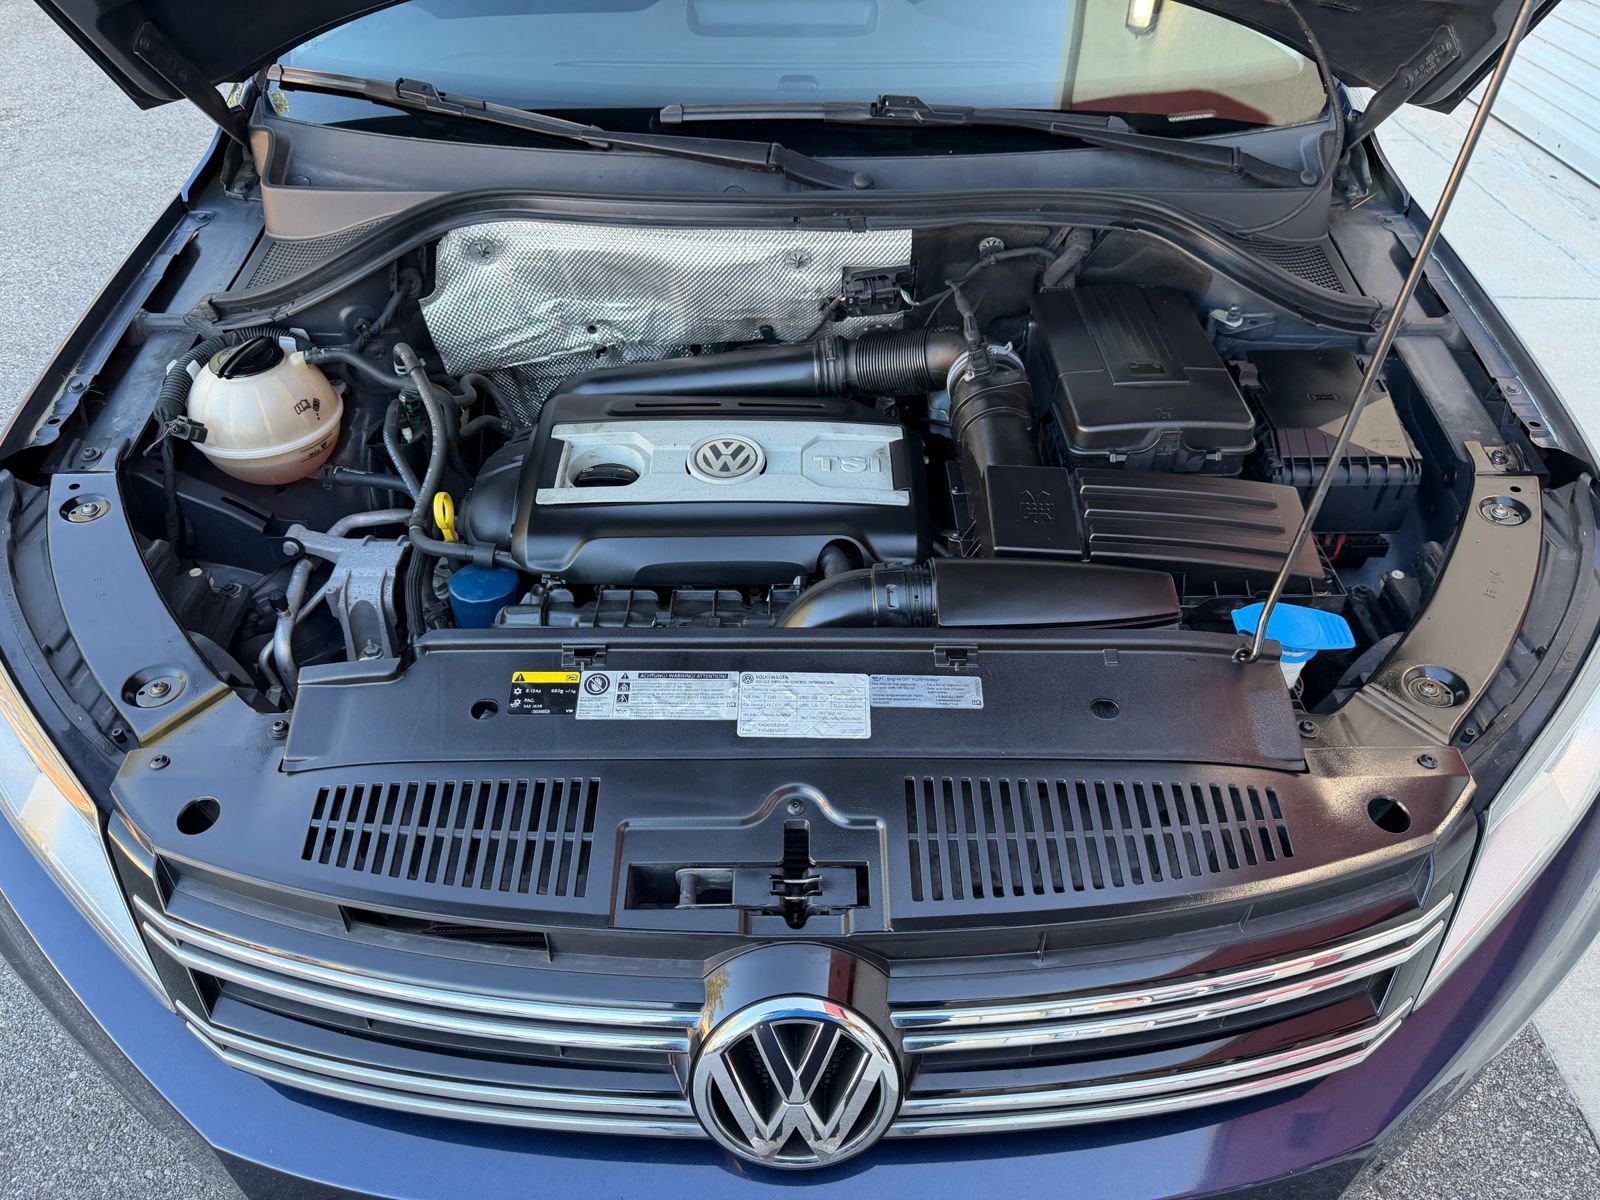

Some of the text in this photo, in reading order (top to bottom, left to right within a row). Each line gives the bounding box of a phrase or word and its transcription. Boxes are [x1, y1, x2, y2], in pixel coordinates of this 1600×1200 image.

[695, 438, 758, 478] VW
[812, 455, 882, 473] TSI
[696, 1006, 897, 1167] VW
